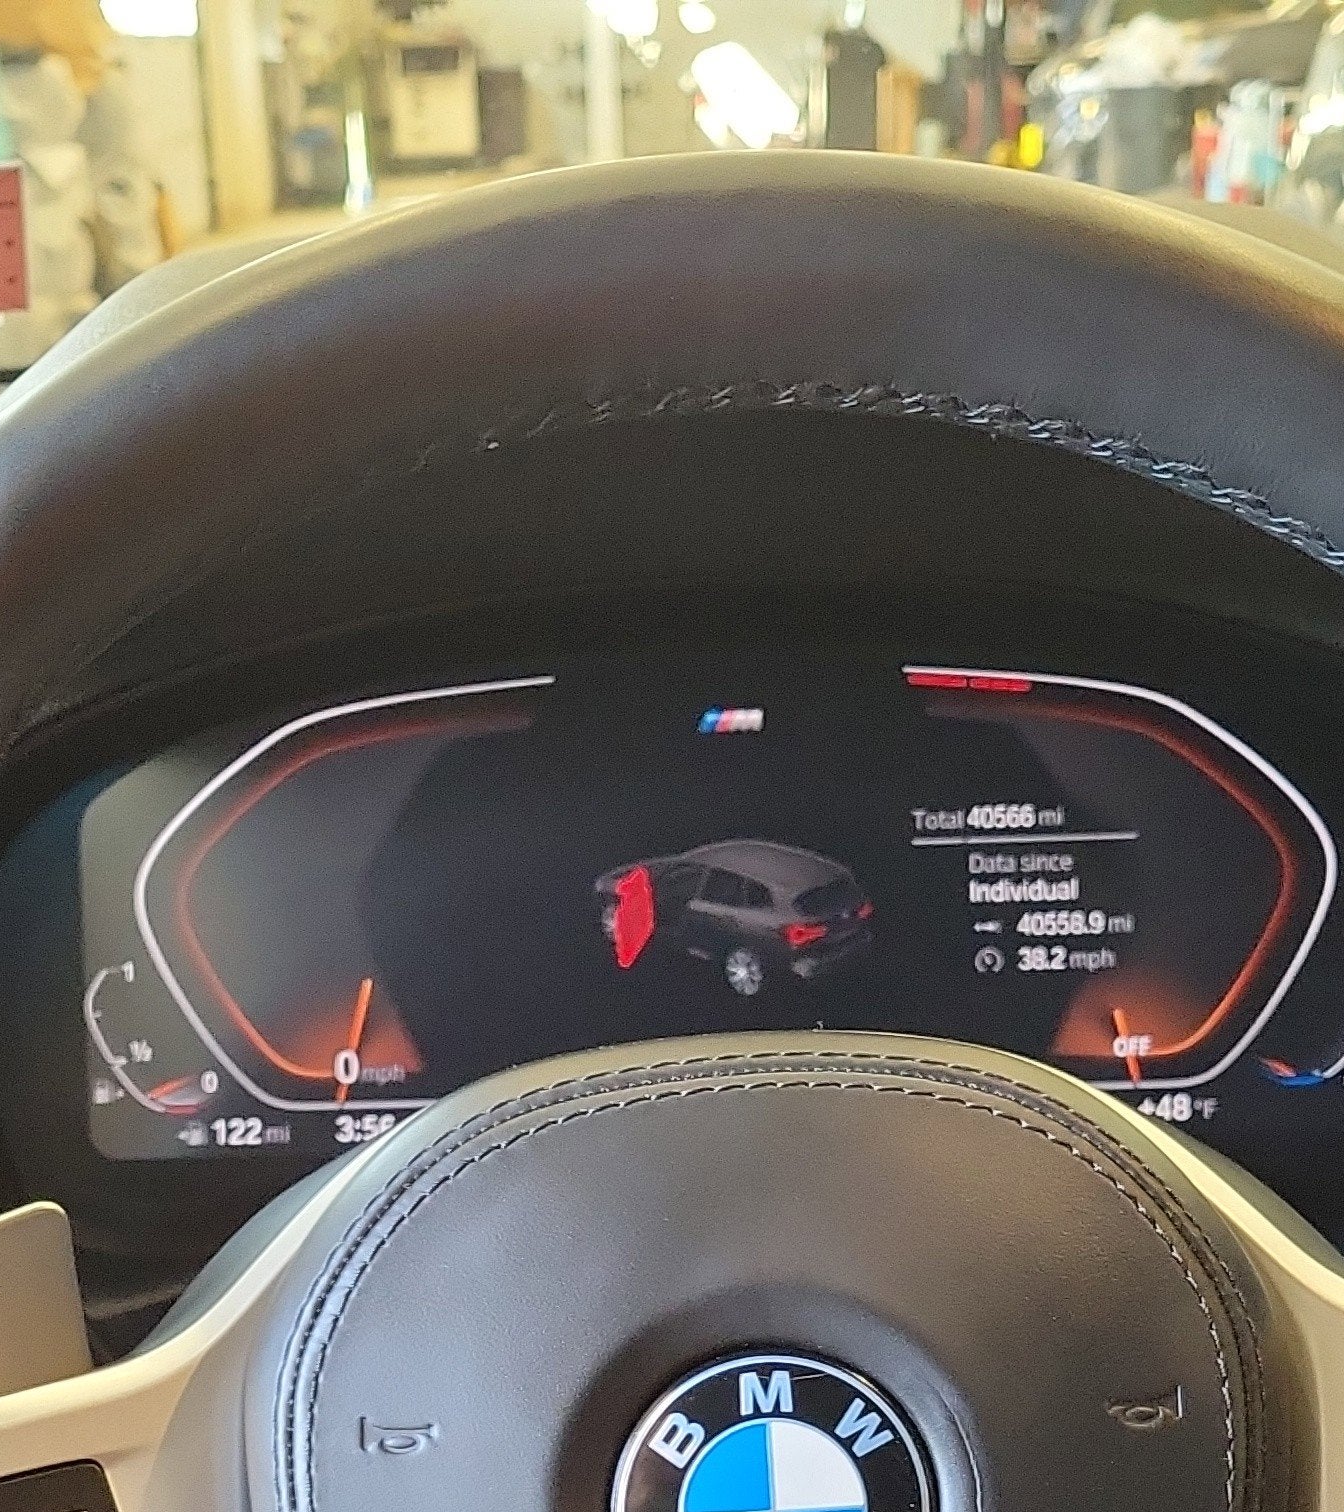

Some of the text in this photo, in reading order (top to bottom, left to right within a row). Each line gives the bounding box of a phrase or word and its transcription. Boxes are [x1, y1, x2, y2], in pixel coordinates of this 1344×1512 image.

[911, 803, 1065, 830] Total 40566 mi
[969, 853, 1074, 874] Data since
[969, 877, 1079, 903] Individual
[1017, 911, 1135, 936] 40558.9 mi
[1018, 945, 1116, 972] 38.2 mph
[1113, 1035, 1152, 1057] OFF
[334, 1050, 406, 1085] 0 mph
[201, 1071, 218, 1093] 0
[211, 1117, 291, 1146] 122 mi
[647, 1369, 893, 1469] BMW
